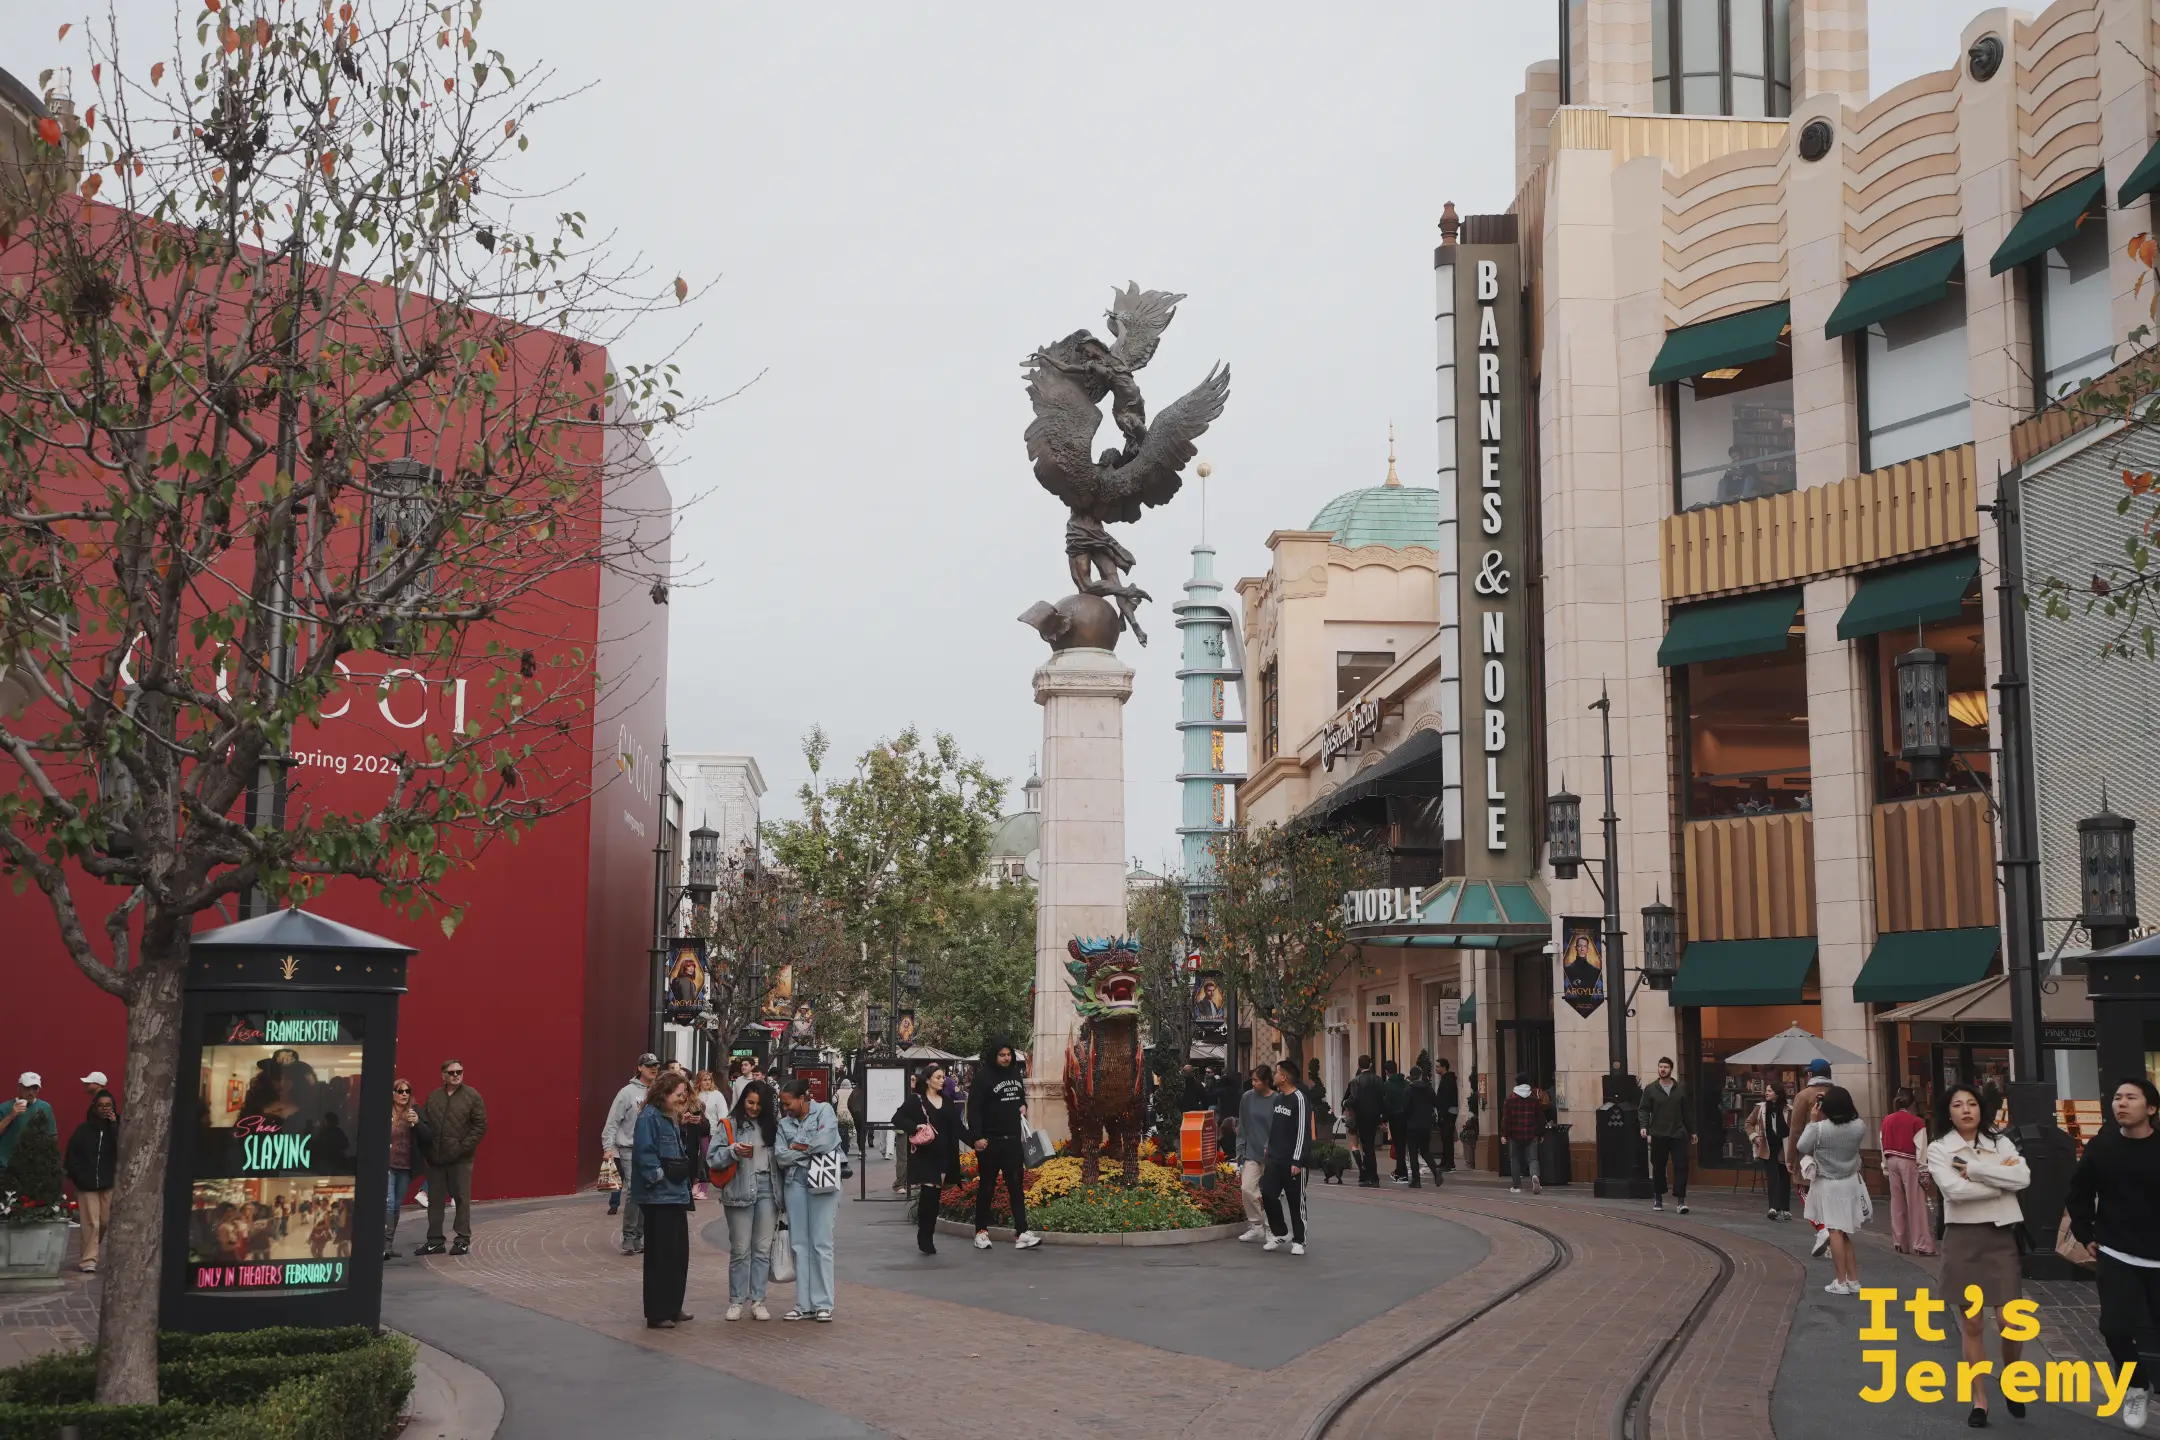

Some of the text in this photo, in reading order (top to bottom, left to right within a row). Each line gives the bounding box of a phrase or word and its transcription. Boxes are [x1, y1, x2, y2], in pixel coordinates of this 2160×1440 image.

[1475, 260, 1511, 850] BARNES & NOBLE
[352, 754, 401, 776] 2024
[618, 723, 653, 806] GUCCI
[1354, 887, 1425, 923] NOBLE
[1565, 987, 1604, 997] ARGYLLE
[228, 1020, 339, 1042] Lisa FRANKENSTEIN
[2045, 1029, 2066, 1038] PINK
[233, 1115, 282, 1138] She's
[242, 1133, 312, 1171] SLAYING
[197, 1262, 343, 1288] ONLY IN THEATERS FEBRUARY 9
